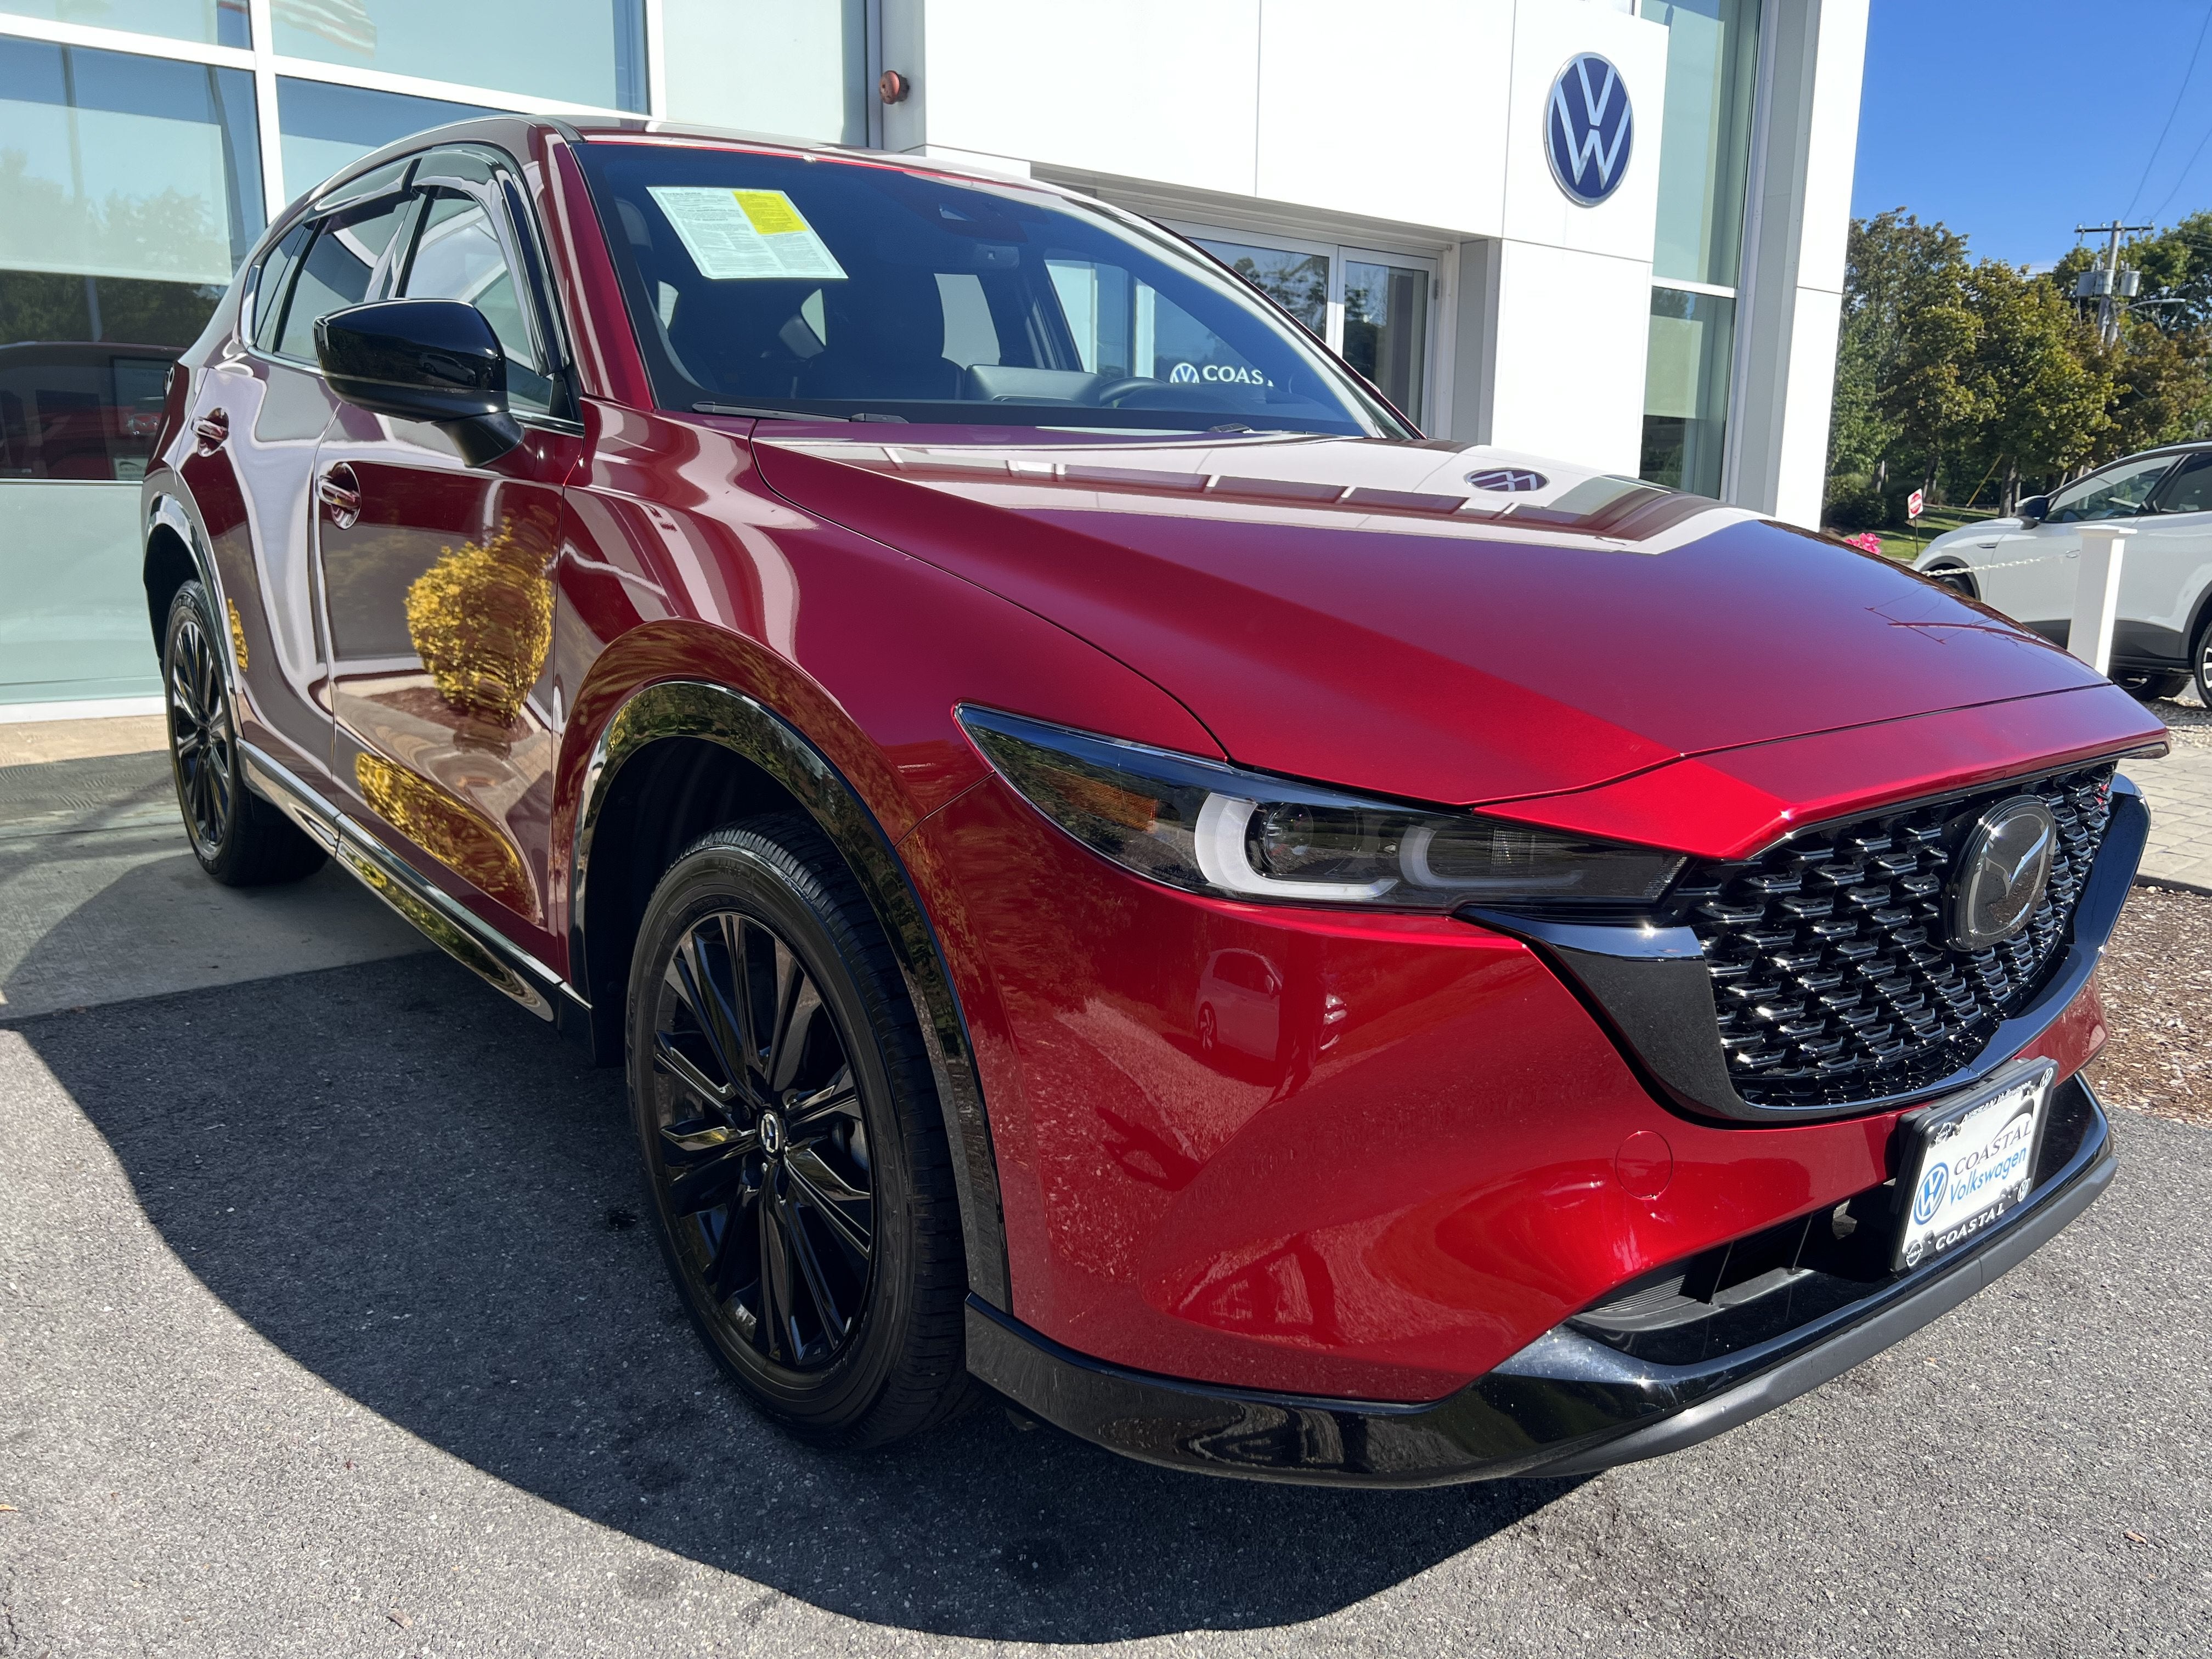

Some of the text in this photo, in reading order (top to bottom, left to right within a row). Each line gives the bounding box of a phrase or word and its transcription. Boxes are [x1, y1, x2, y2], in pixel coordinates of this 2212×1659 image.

[1203, 364, 1274, 387] COAS
[1954, 1120, 2031, 1176] COASTAL
[1950, 1147, 2027, 1206] Volkswagen
[1935, 1203, 2005, 1252] COASTAL
